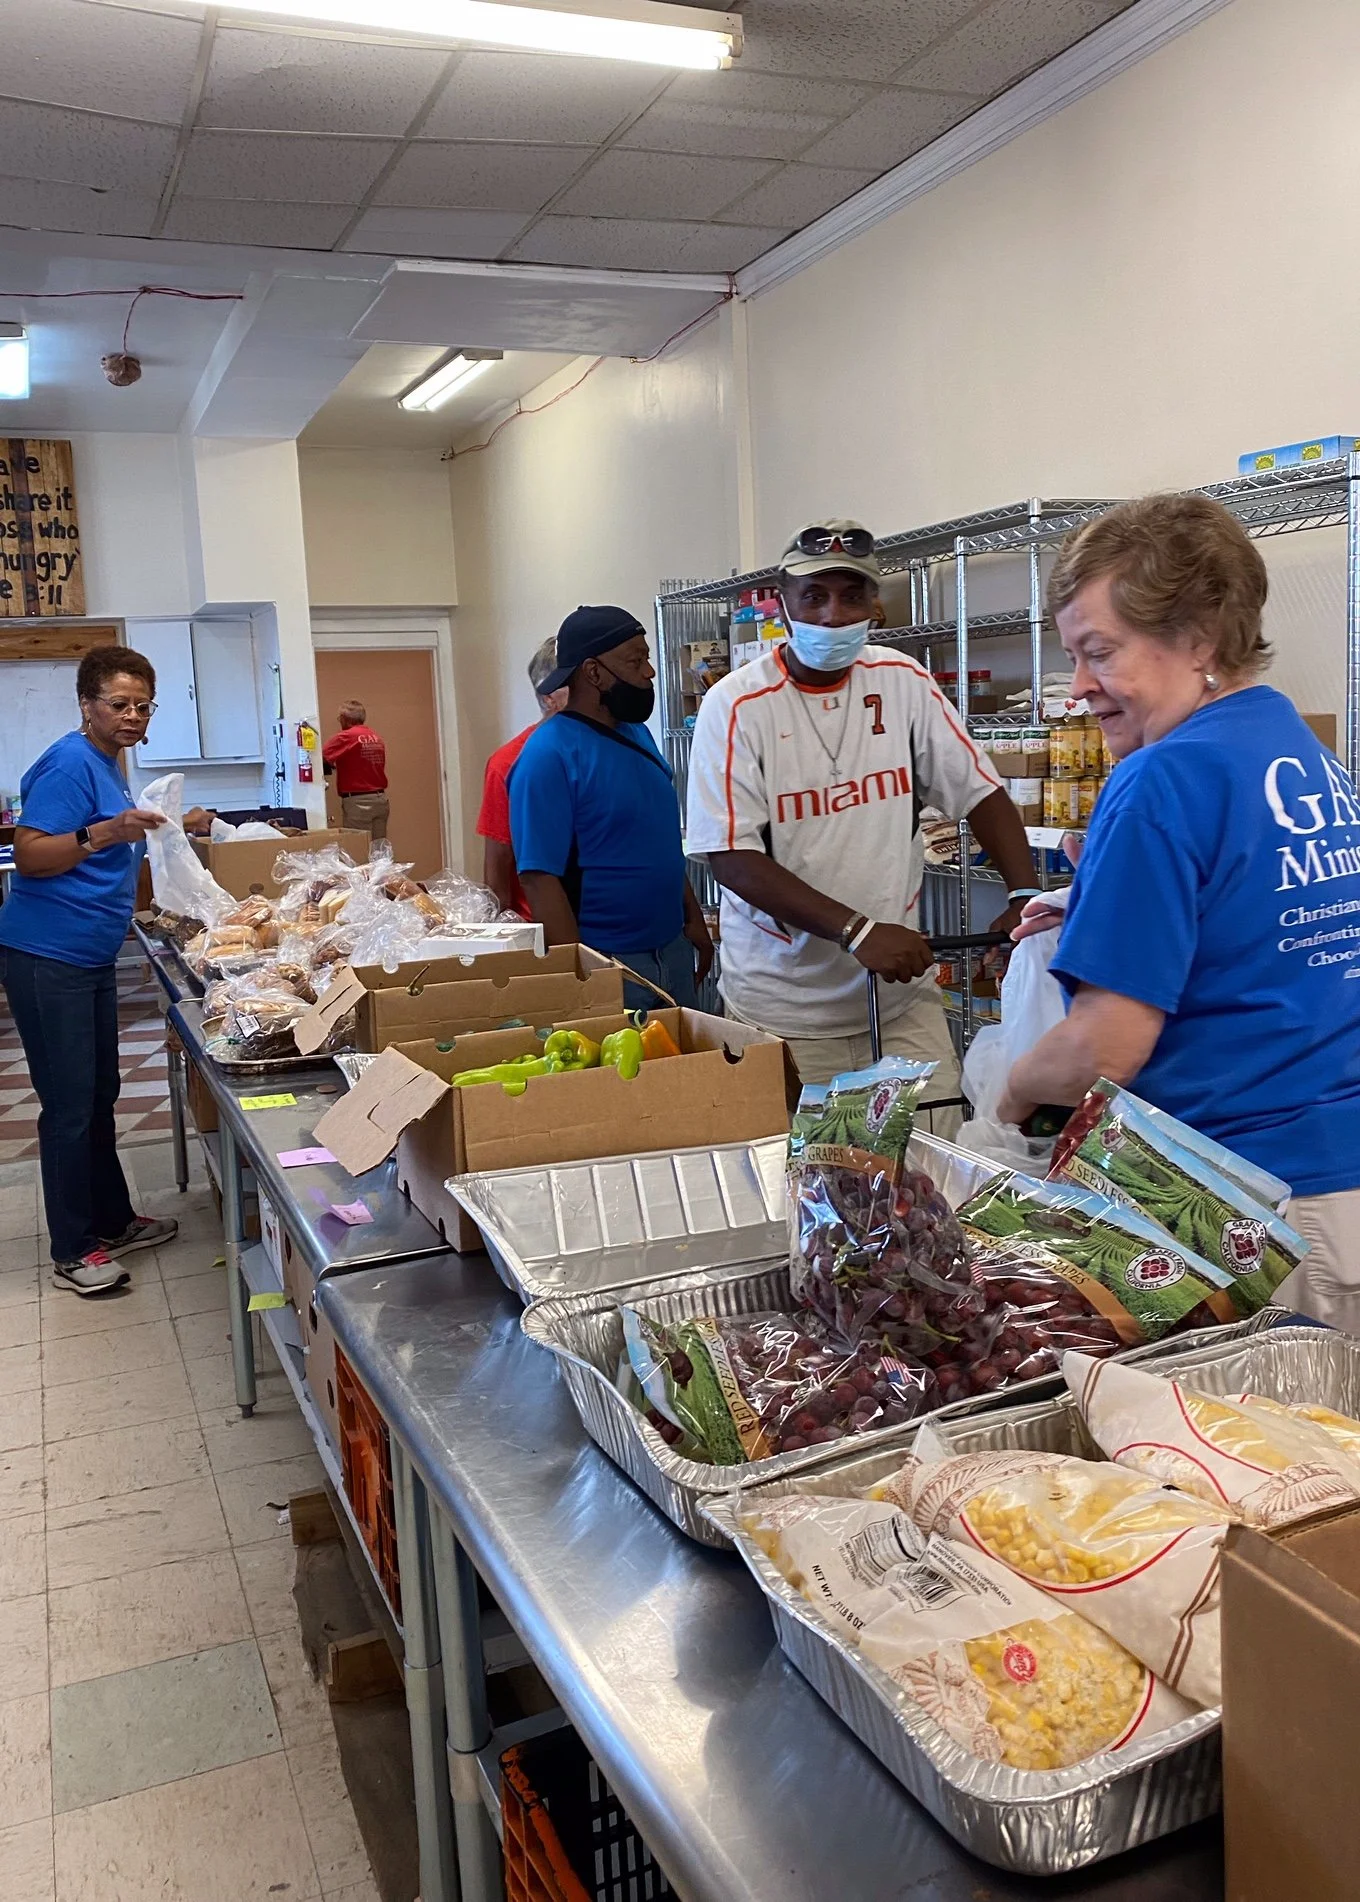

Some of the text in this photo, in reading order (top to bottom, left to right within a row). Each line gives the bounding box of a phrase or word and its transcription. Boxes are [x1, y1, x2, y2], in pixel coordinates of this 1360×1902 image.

[56, 487, 73, 510] it
[38, 517, 78, 539] who
[823, 694, 886, 736] U 7
[808, 1145, 844, 1162] GRAPES
[1222, 1241, 1254, 1272] CALIFORNIA
[1126, 1269, 1162, 1289] CALIFORNIA
[733, 1402, 755, 1435] RED
[812, 1564, 826, 1582] NET
